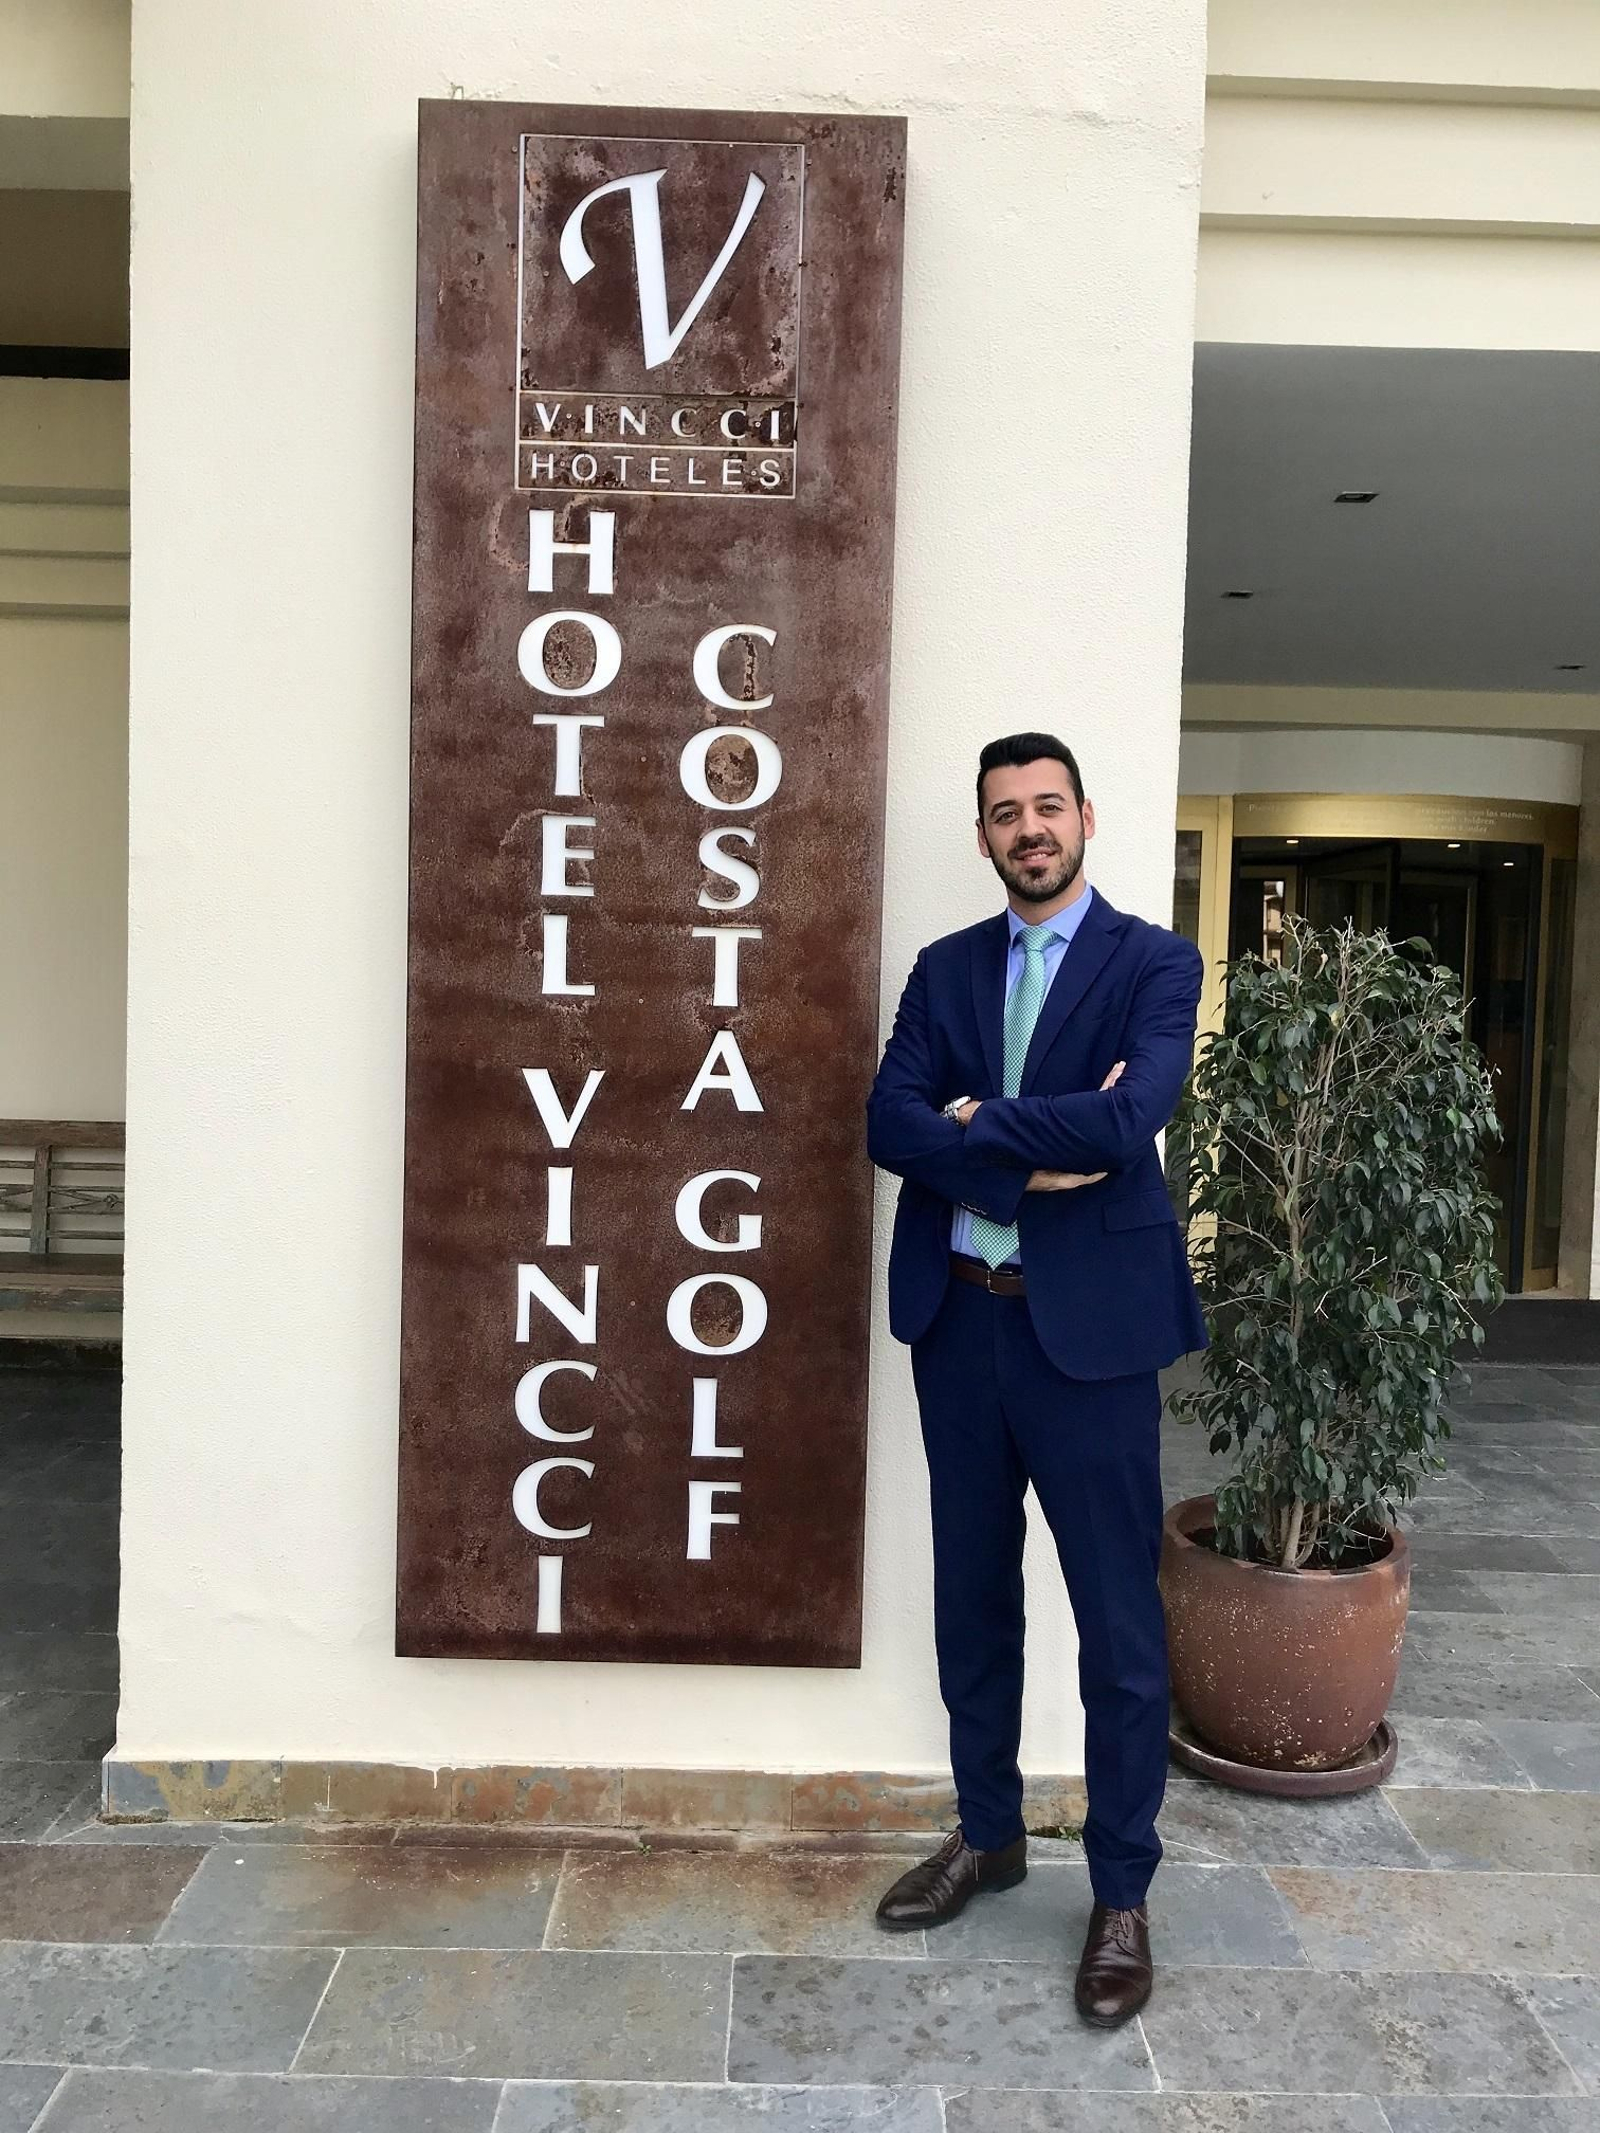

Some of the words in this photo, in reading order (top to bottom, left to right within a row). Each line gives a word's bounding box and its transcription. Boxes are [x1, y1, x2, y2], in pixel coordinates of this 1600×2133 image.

[535, 402, 781, 440] VINCCI
[560, 169, 765, 370] V
[530, 451, 782, 487] HOTELES
[517, 510, 622, 996] HOTEL
[679, 624, 783, 1112] COSTA
[512, 1068, 606, 1633] VINCCI
[666, 1169, 768, 1560] GOLF
